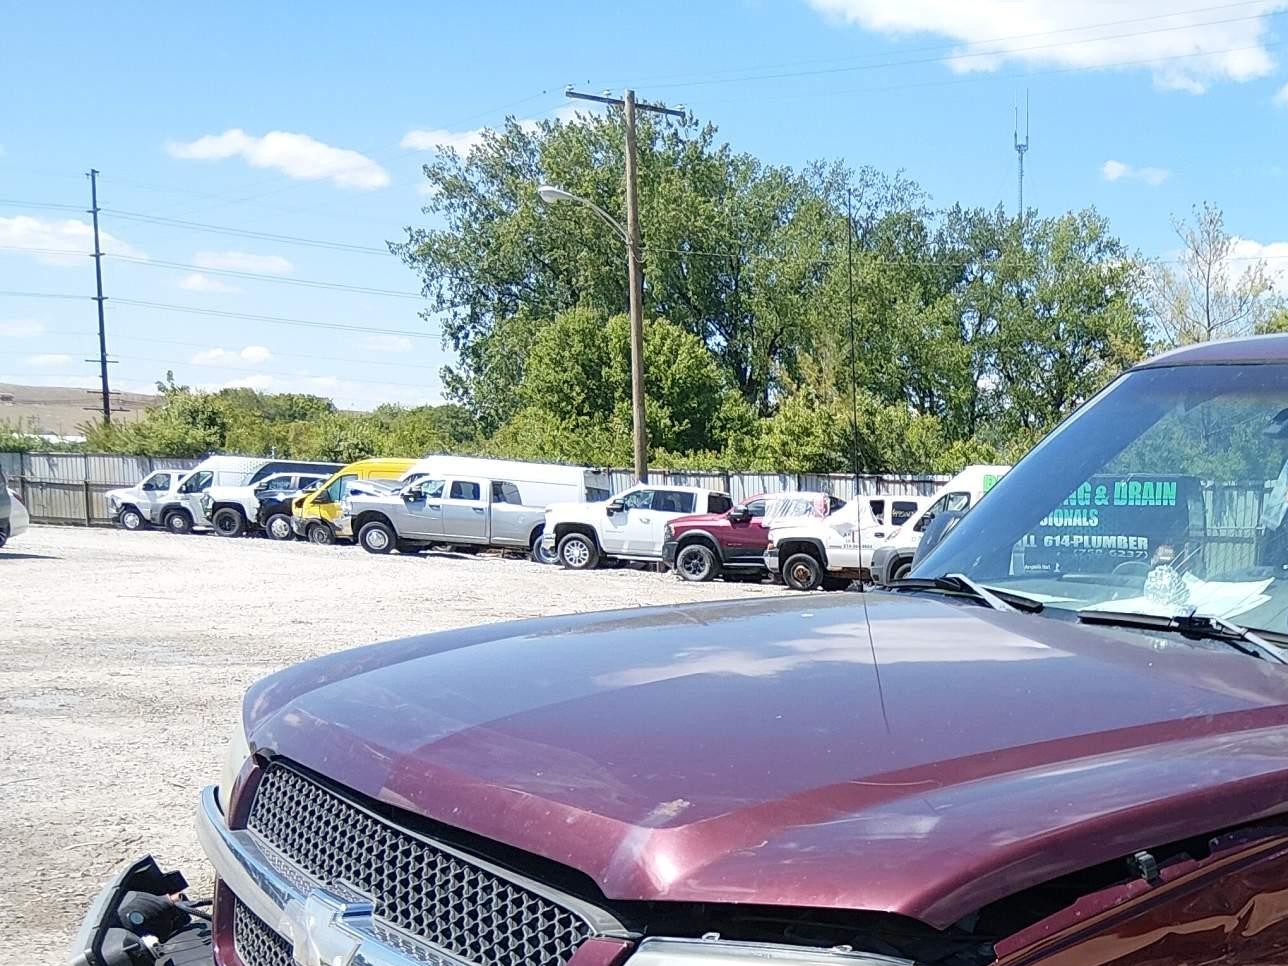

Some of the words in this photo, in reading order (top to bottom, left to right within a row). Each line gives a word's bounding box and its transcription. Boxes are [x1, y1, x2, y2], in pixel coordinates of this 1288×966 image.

[1064, 481, 1091, 506] NG
[1094, 485, 1109, 506] &
[1113, 481, 1177, 506] DRAIN
[1043, 535, 1149, 551] 614-PLUMBER
